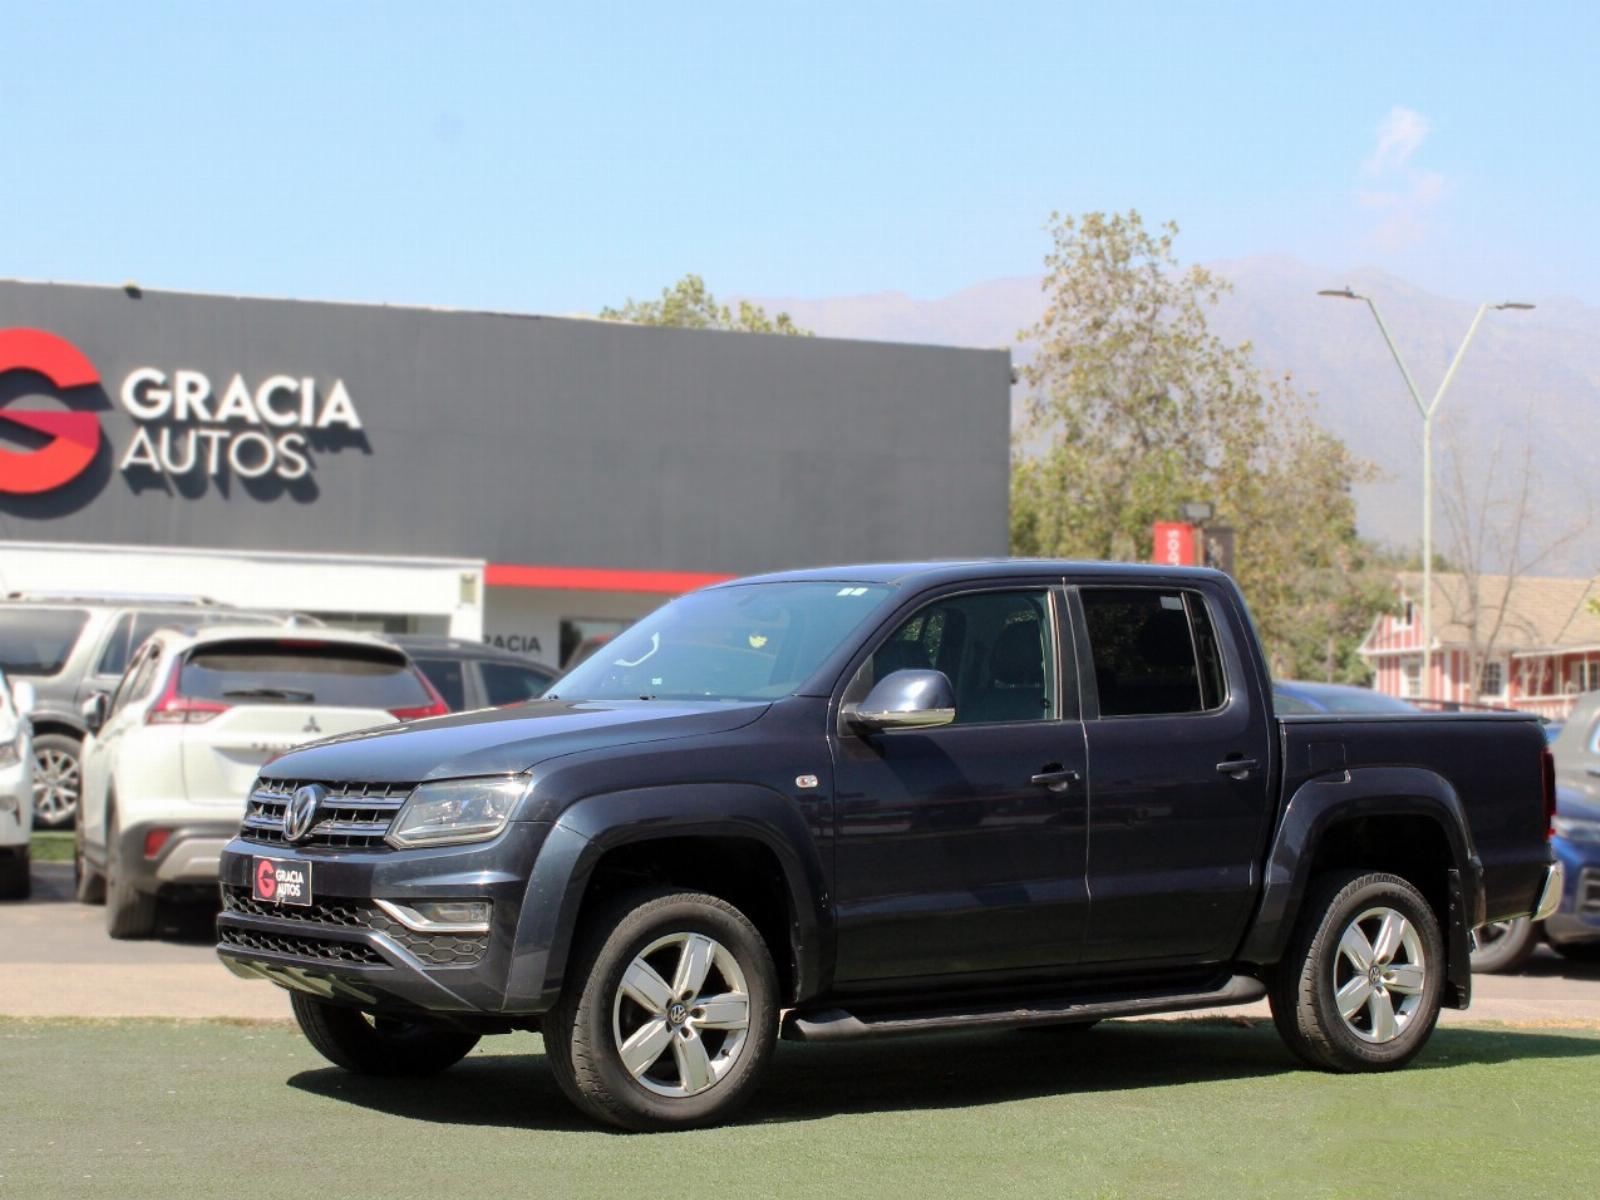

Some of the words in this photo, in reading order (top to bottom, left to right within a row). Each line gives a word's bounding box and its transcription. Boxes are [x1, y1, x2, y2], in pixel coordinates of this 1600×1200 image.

[120, 367, 363, 429] GRACIA
[120, 426, 309, 480] AUTOS
[1167, 529, 1180, 566] DOS
[275, 869, 304, 884] GRACIA
[276, 883, 301, 897] AUTOS
